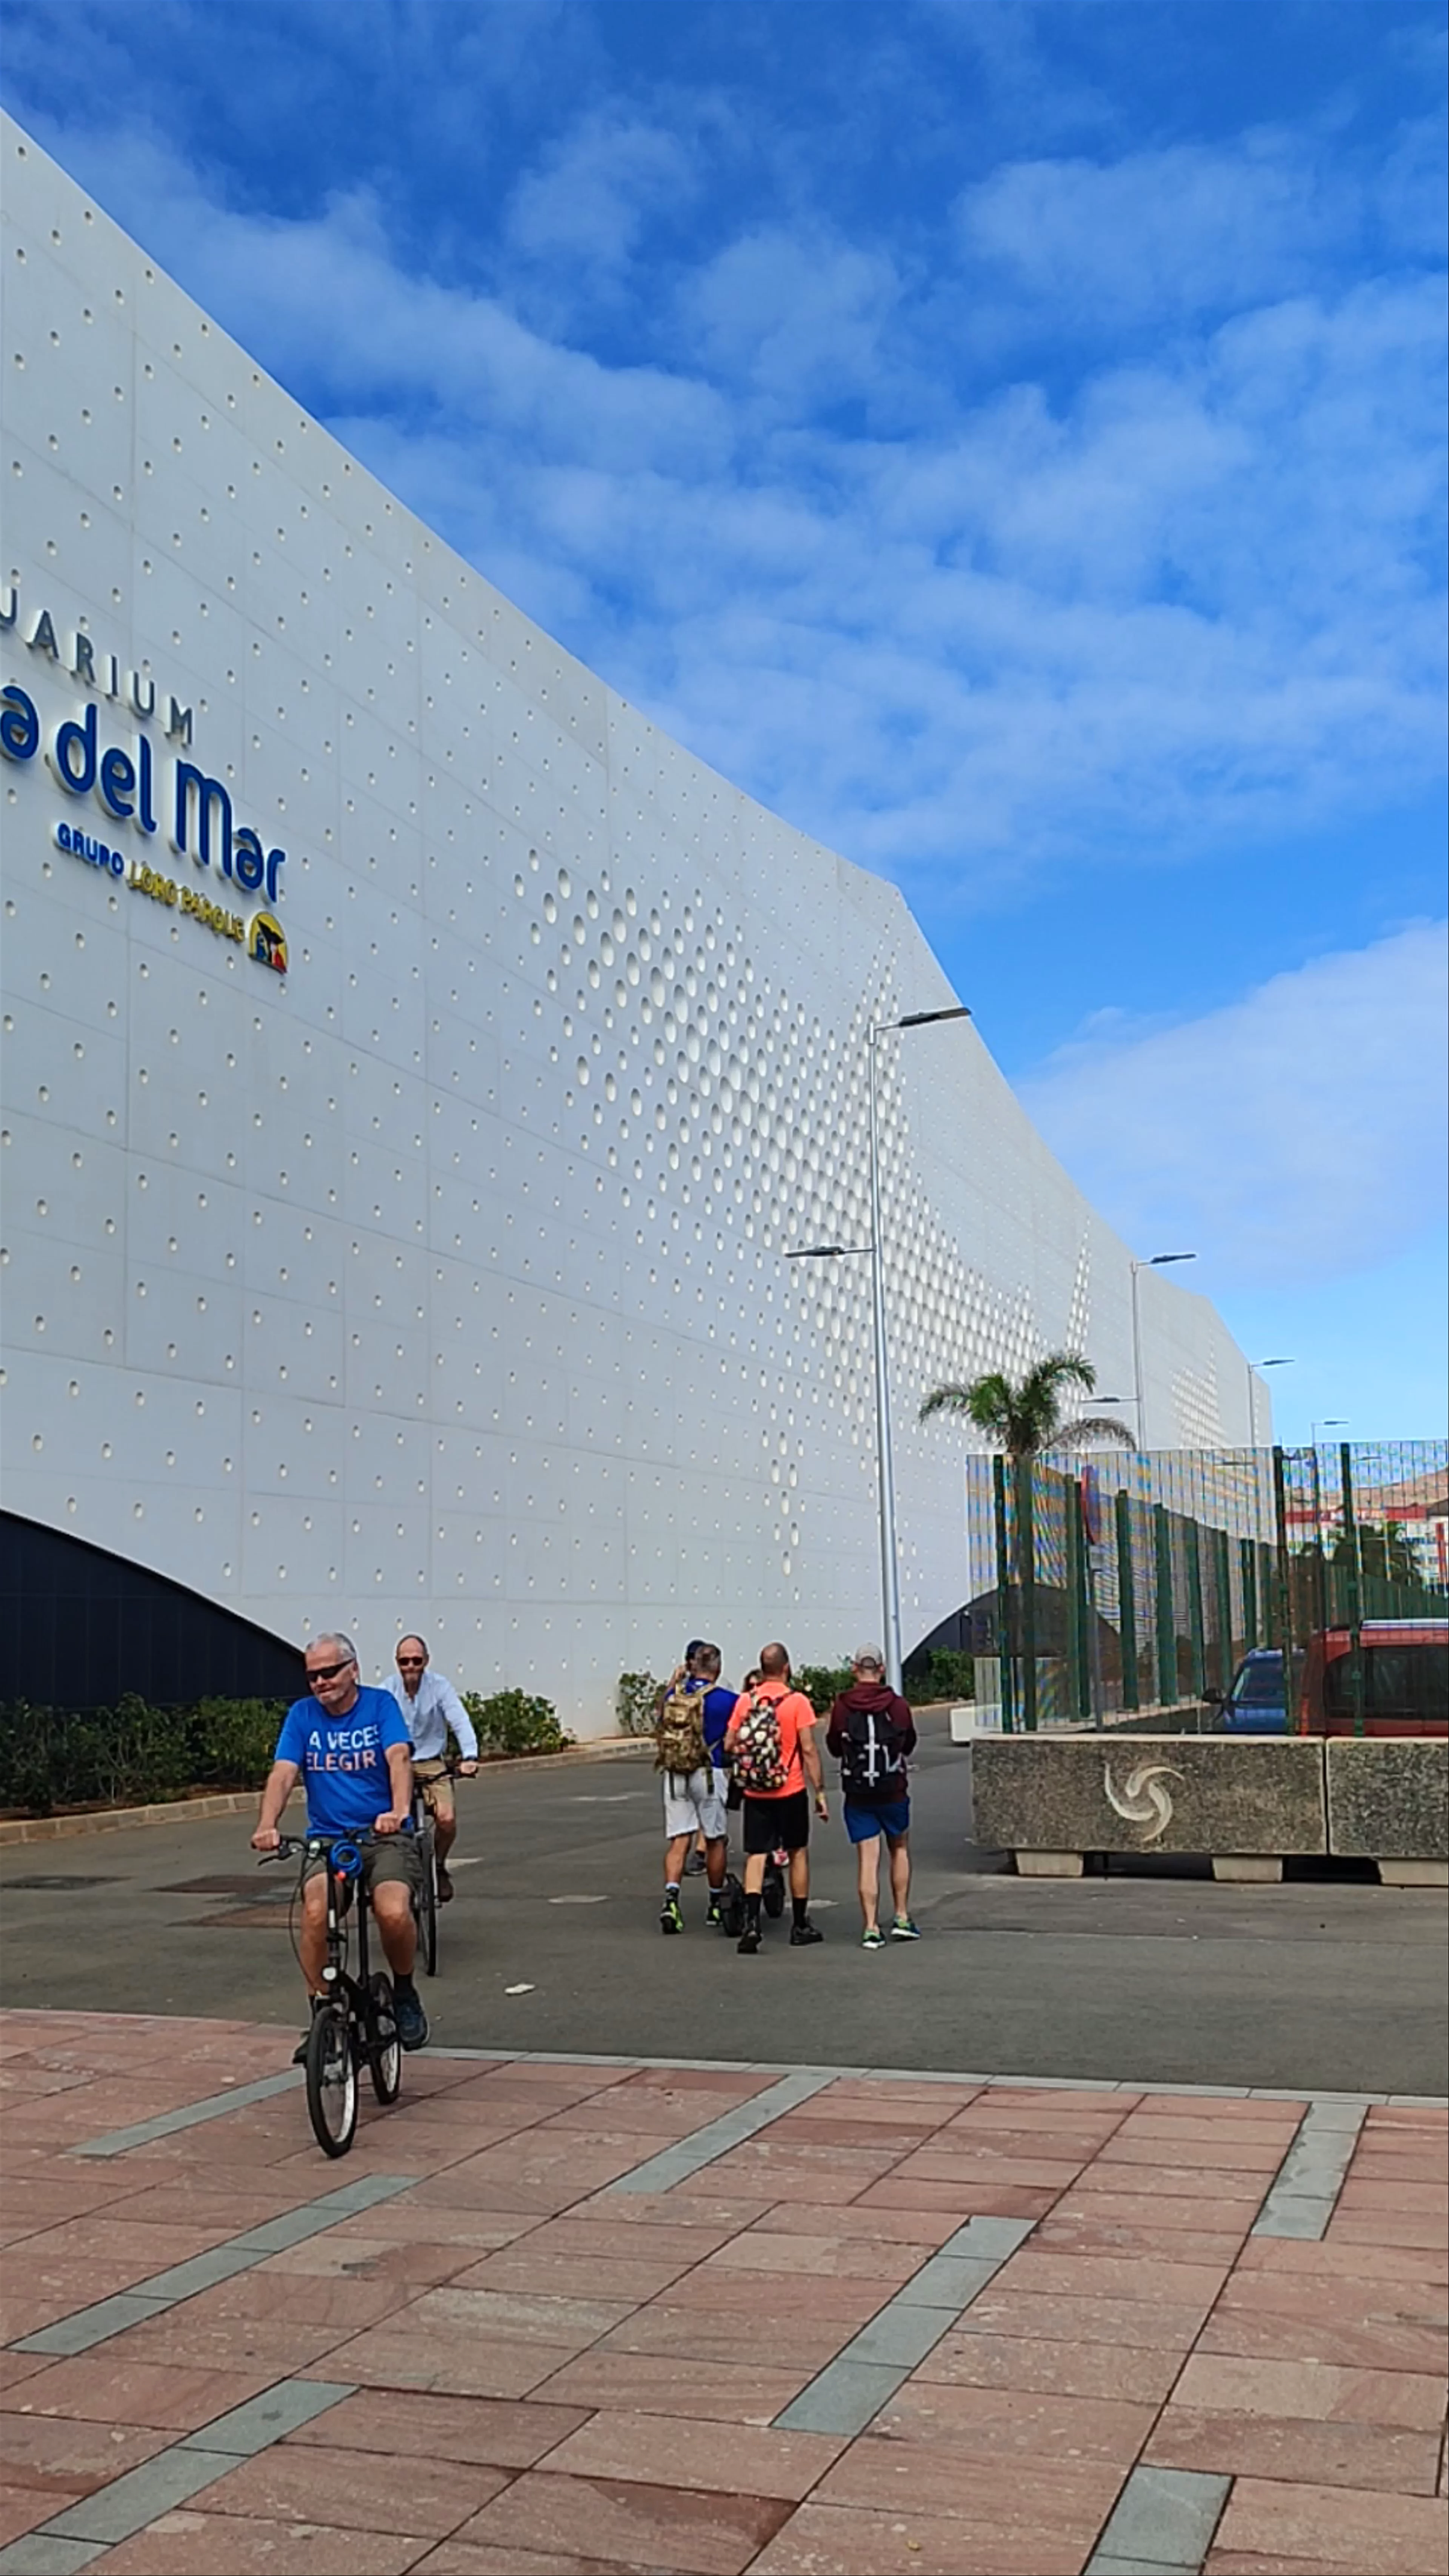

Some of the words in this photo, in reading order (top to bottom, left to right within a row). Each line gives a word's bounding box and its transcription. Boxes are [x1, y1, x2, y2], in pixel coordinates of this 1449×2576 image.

[57, 703, 157, 833] del
[57, 823, 125, 875] GRUPO
[309, 1730, 321, 1750] A
